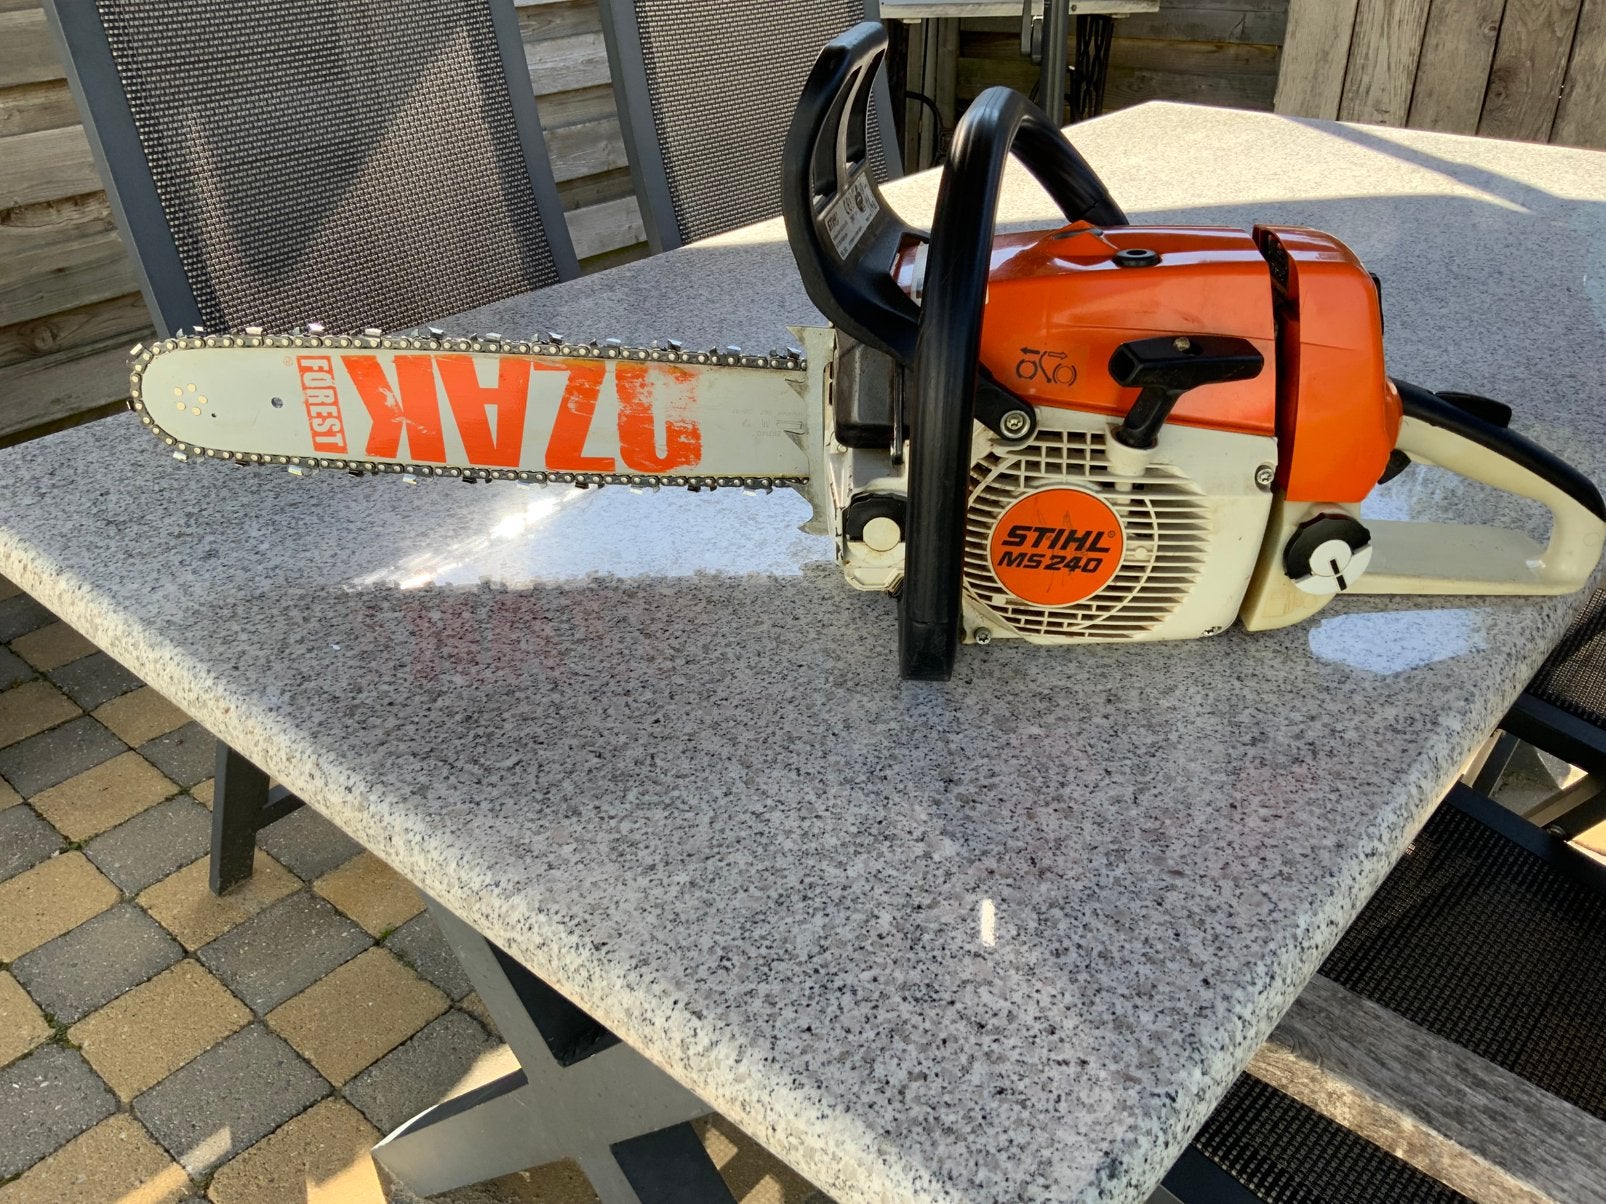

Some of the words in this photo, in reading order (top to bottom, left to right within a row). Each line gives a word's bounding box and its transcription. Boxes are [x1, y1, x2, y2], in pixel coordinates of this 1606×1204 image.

[300, 358, 344, 447] FOREST
[1002, 525, 1111, 553] STIHL
[997, 551, 1046, 569] MS
[1043, 555, 1103, 574] 240
